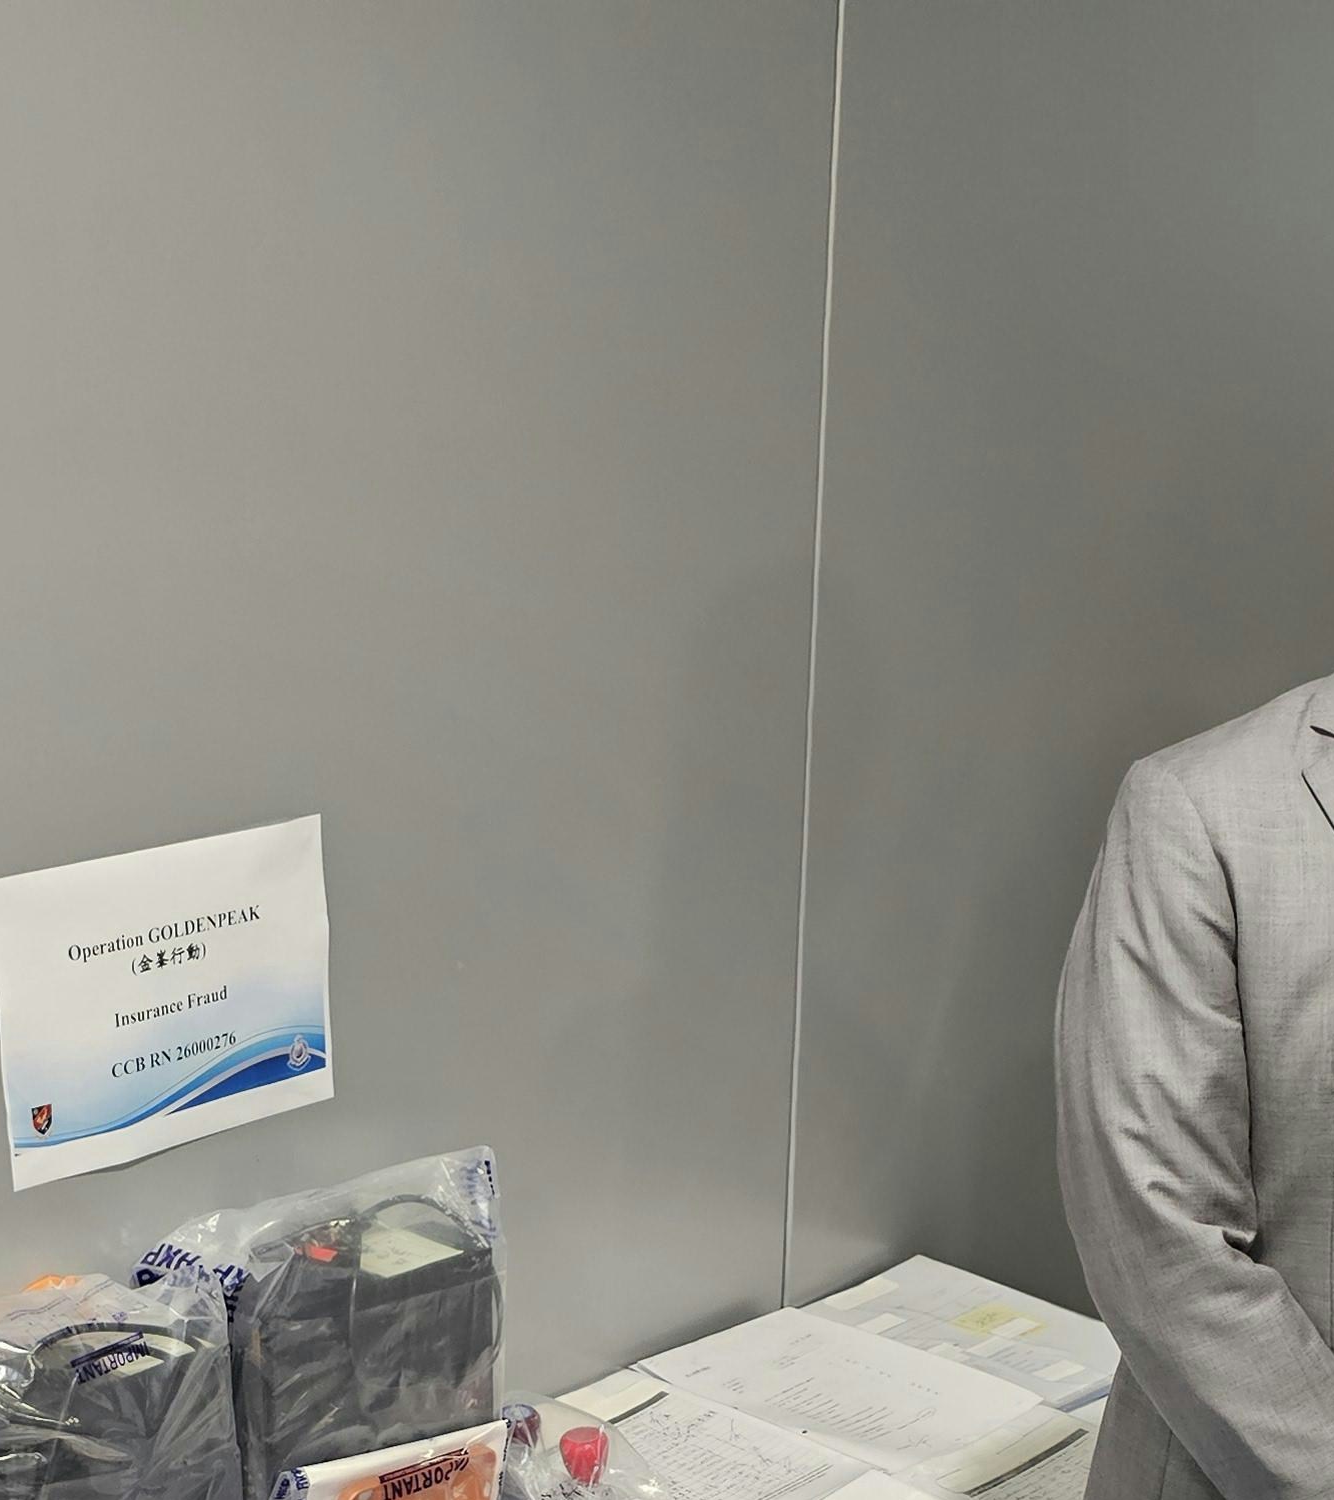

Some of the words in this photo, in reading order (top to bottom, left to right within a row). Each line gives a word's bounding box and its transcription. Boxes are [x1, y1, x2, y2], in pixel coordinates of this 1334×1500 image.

[68, 931, 144, 963] Operation
[148, 904, 261, 943] GOLDENPEAK
[114, 1000, 183, 1028] Insurance
[187, 985, 229, 1009] Fraud
[111, 1059, 146, 1079] CCB
[150, 1052, 173, 1070] RN
[176, 1030, 237, 1062] 26000276
[76, 1342, 151, 1385] IMPORTANT
